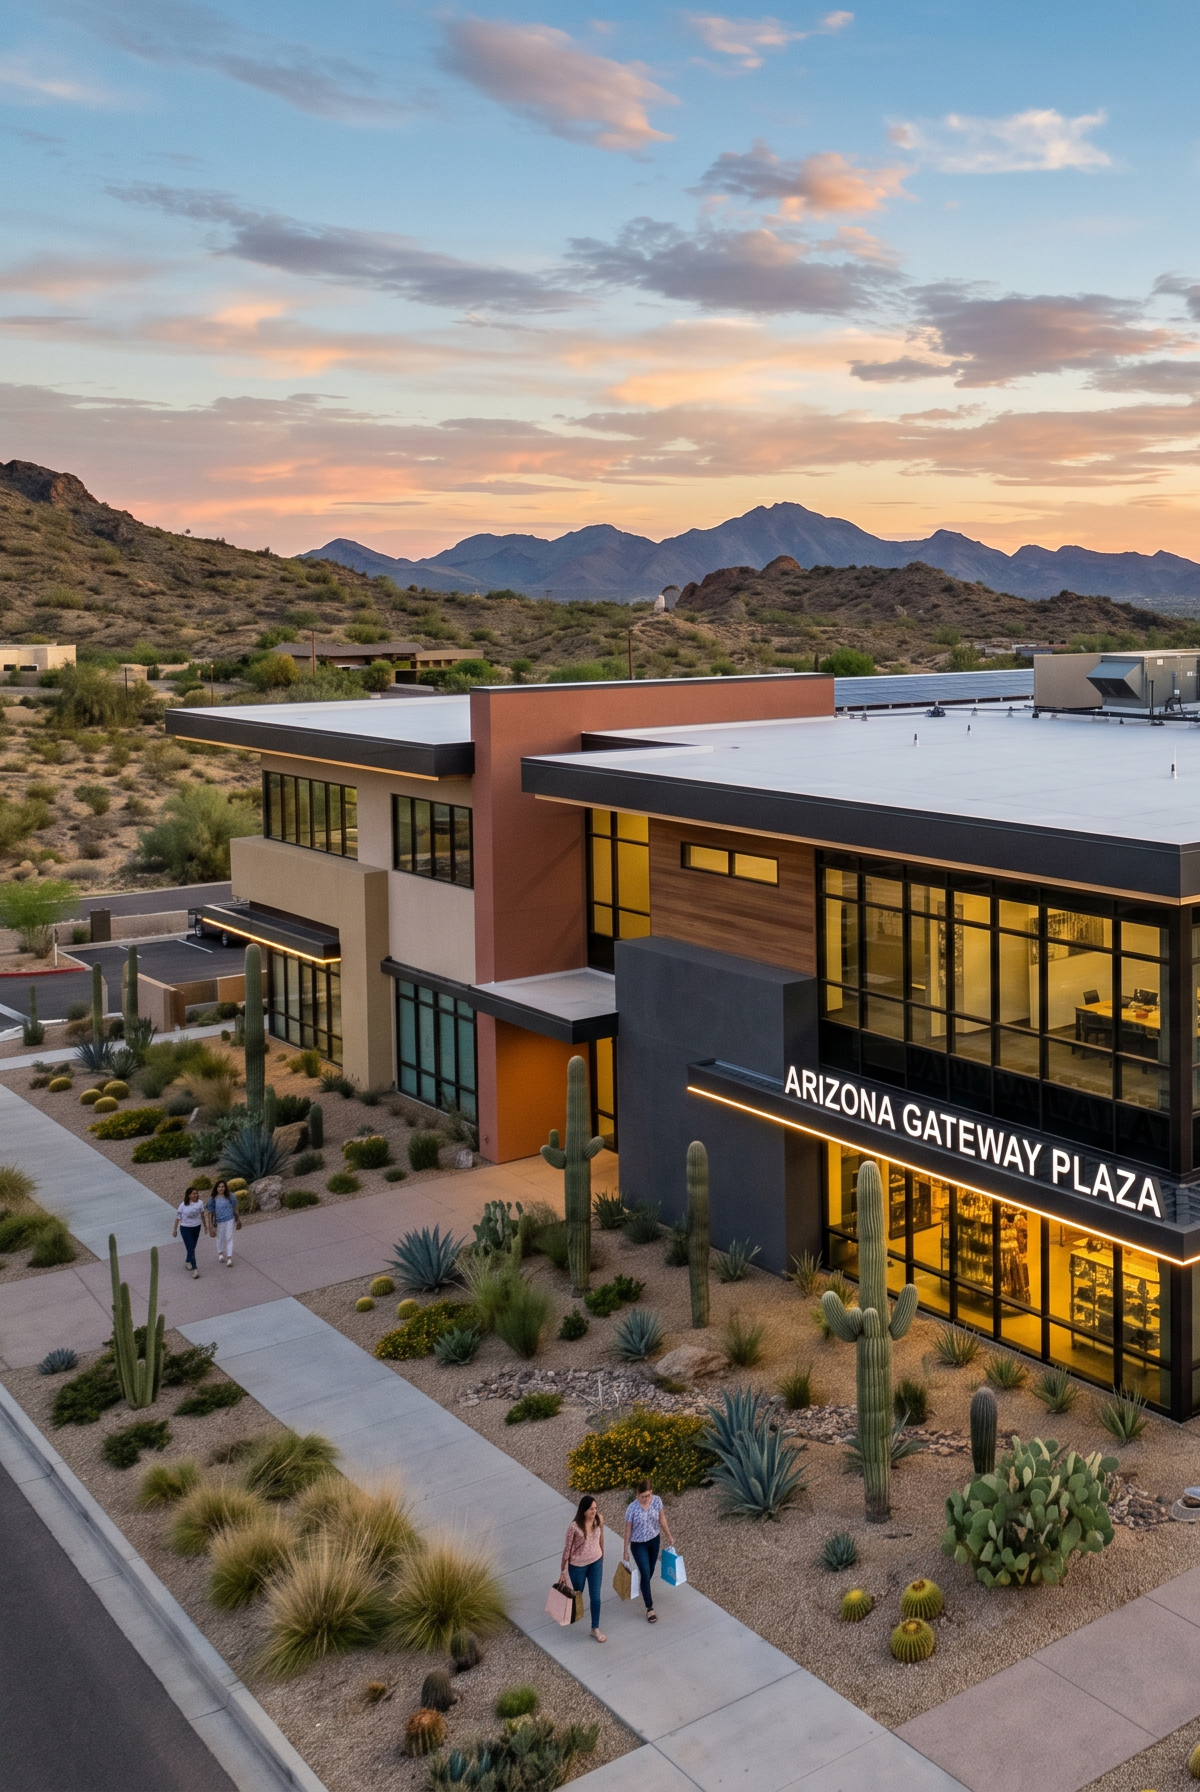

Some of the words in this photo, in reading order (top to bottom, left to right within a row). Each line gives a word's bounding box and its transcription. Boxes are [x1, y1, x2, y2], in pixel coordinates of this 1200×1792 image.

[784, 1066, 896, 1130] ARIZONA
[902, 1103, 1043, 1176] GATEWAY
[1052, 1148, 1162, 1218] PLAZA
